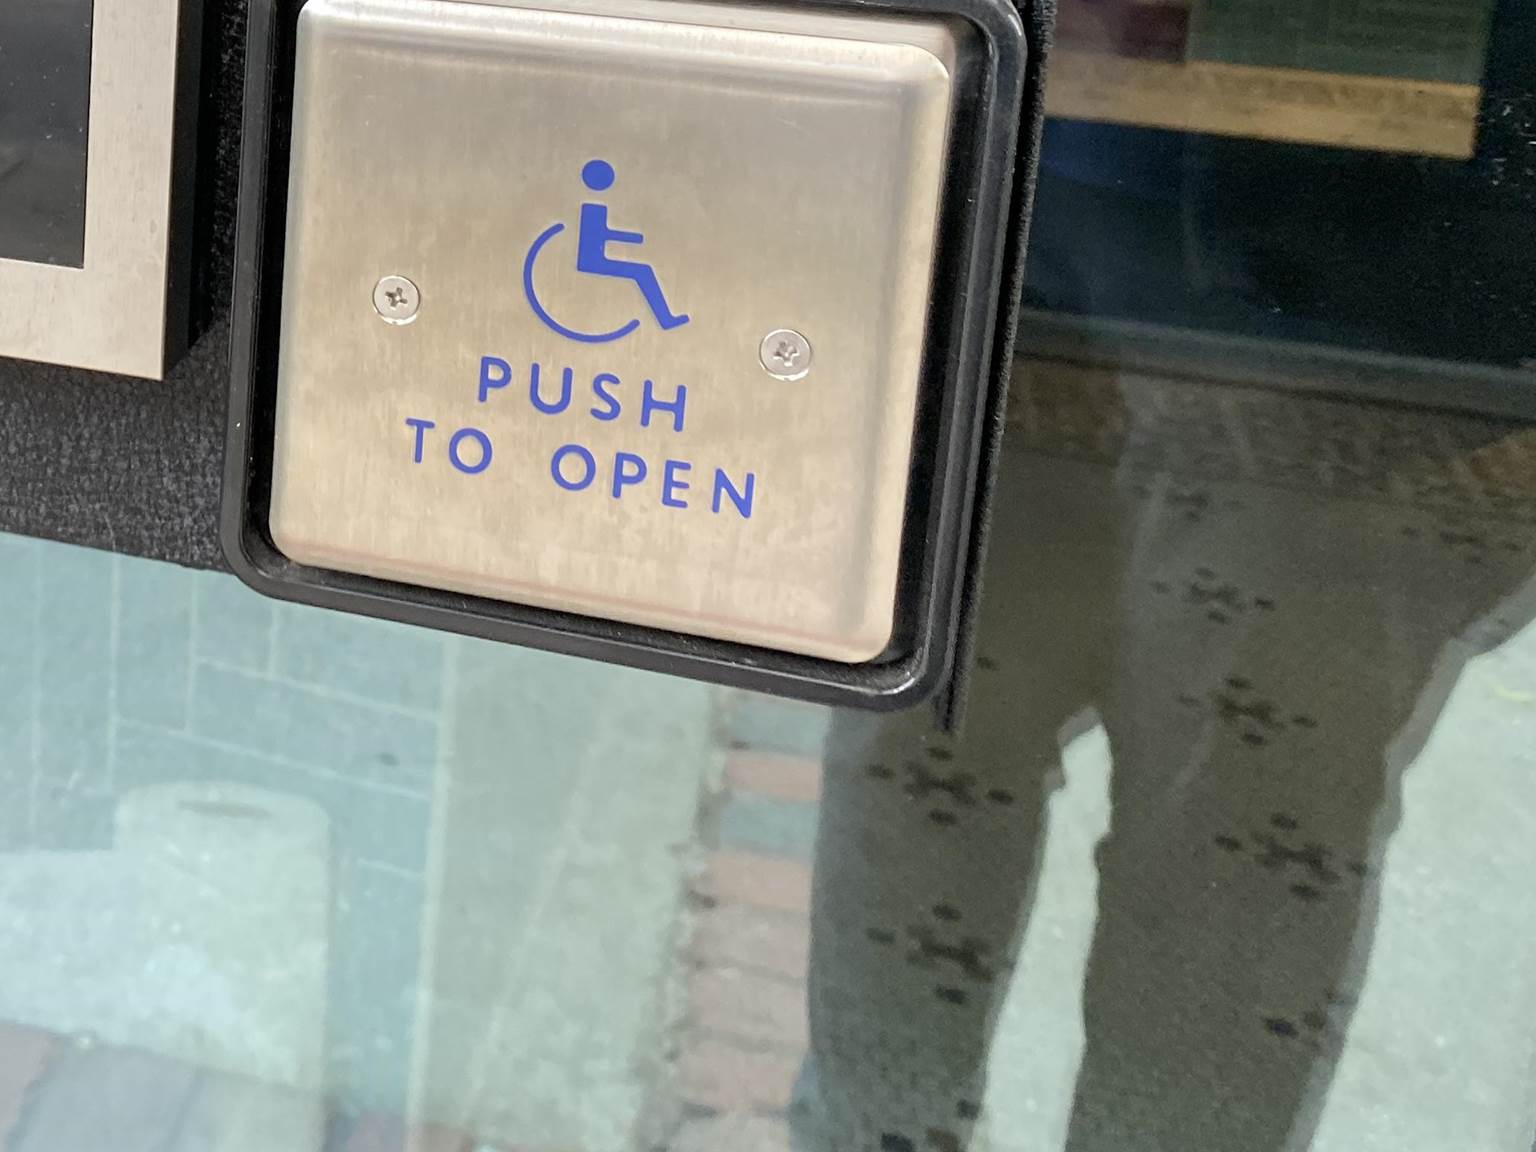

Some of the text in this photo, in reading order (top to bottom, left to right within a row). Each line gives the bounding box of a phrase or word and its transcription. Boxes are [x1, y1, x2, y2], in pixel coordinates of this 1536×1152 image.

[477, 356, 688, 433] PUSH
[405, 417, 756, 519] TO OPEN
